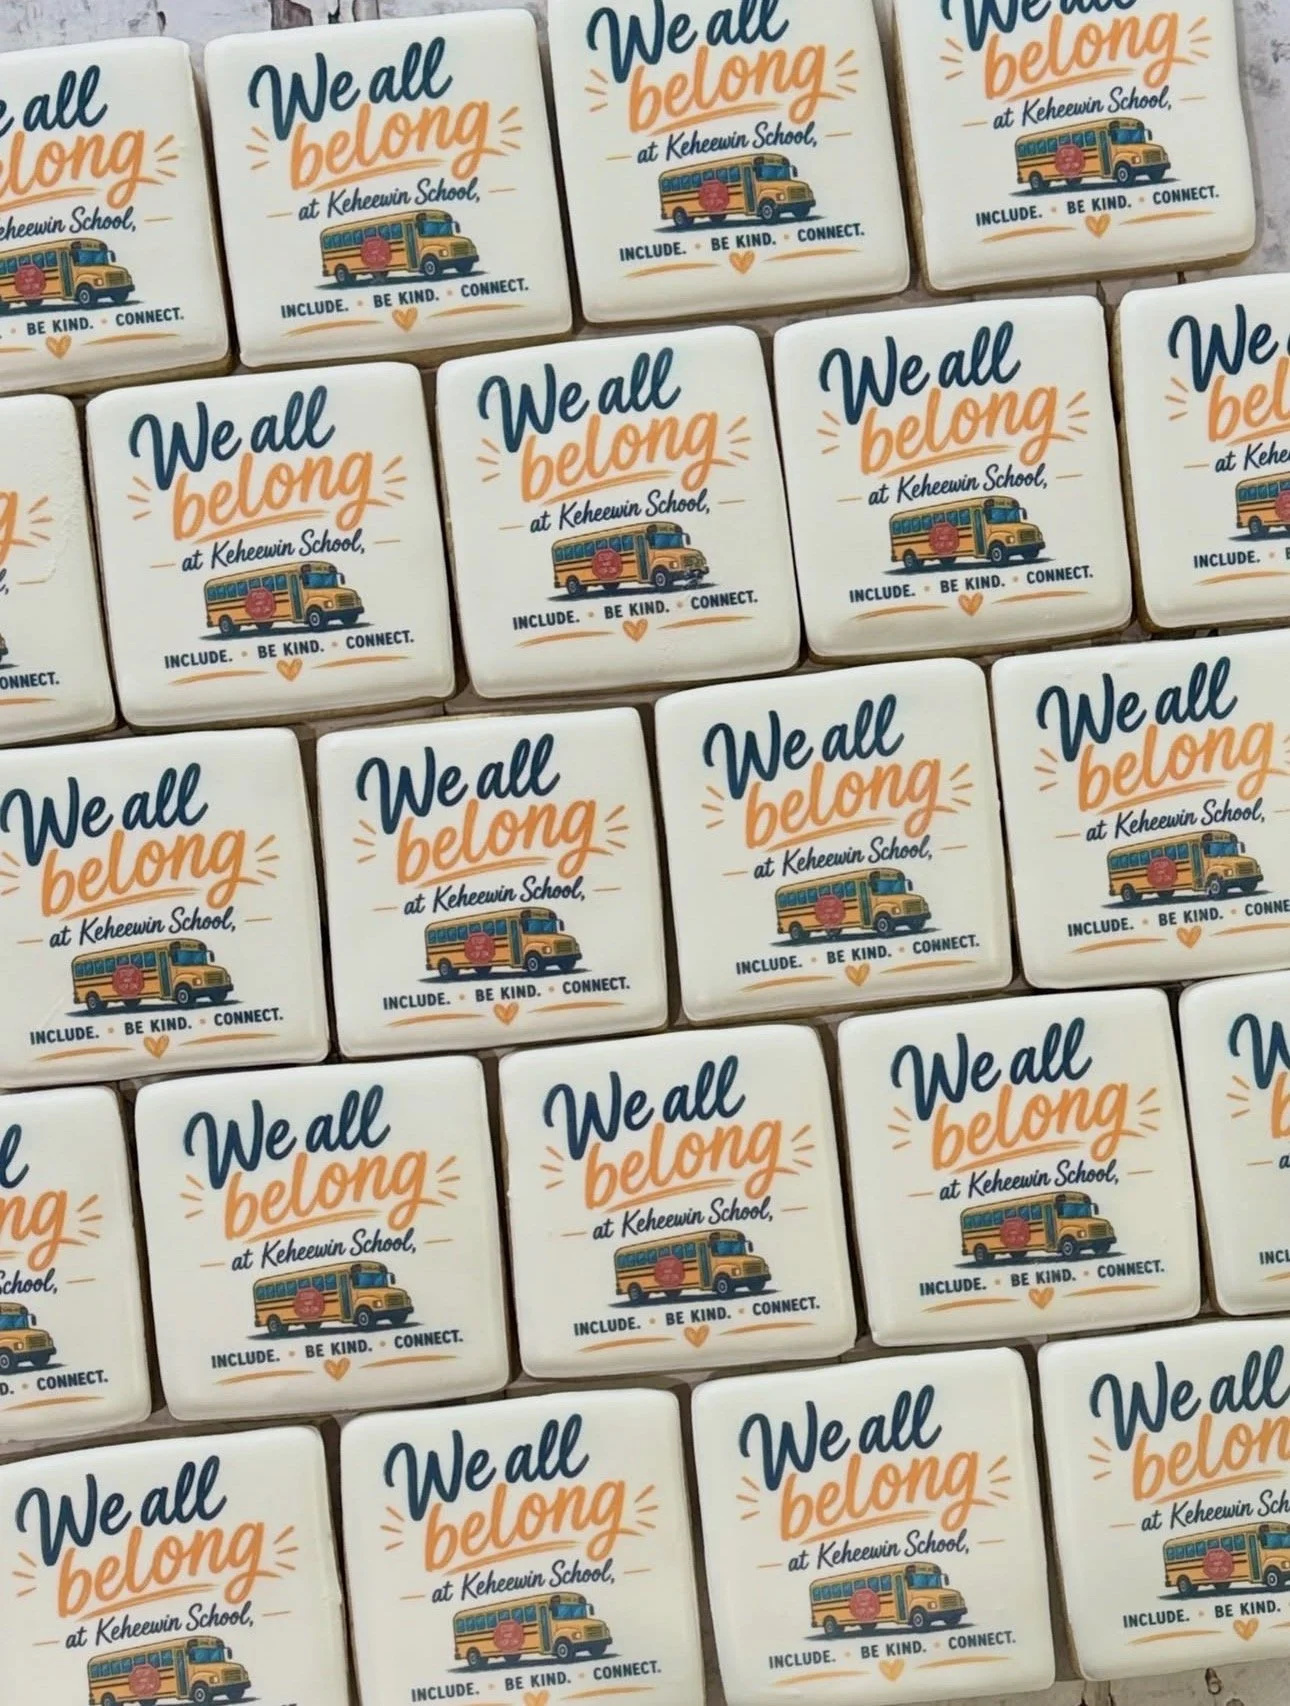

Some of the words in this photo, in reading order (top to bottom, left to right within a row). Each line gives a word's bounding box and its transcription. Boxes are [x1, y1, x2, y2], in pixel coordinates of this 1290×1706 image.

[586, 0, 698, 84] We
[706, 0, 790, 46] all
[984, 10, 1191, 99] belong
[22, 65, 108, 132] all
[246, 51, 360, 142] We
[368, 36, 453, 103] all
[628, 44, 837, 133] belong
[993, 107, 1015, 130] at
[1022, 96, 1104, 127] Keheewin
[1107, 85, 1172, 114] School,
[289, 100, 500, 190] belong
[637, 141, 659, 164] at
[666, 131, 750, 162] Keheewin
[752, 120, 817, 149] School,
[69, 205, 136, 234] School,
[976, 204, 1043, 225] INCLUDE.
[1067, 199, 1086, 214] BE
[1091, 194, 1132, 211] KIND.
[1152, 185, 1220, 205] CONNECT.
[619, 241, 687, 261] INCLUDE.
[710, 236, 730, 251] BE
[735, 232, 777, 249] KIND.
[797, 223, 865, 243] CONNECT.
[280, 297, 349, 318] INCLUDE.
[372, 292, 392, 308] BE
[398, 288, 439, 305] KIND.
[460, 278, 529, 298] CONNECT.
[26, 320, 46, 336] BE
[52, 316, 94, 333] KIND.
[115, 307, 184, 327] CONNECT.
[1168, 304, 1280, 393] We
[819, 335, 931, 426] We
[938, 321, 1022, 389] all
[128, 401, 243, 492] We
[250, 386, 336, 454] all
[860, 386, 1068, 475] belong
[868, 484, 890, 506] at
[896, 473, 980, 504] Keheewin
[982, 462, 1047, 492] School,
[1214, 451, 1236, 473] at
[172, 451, 385, 541] belong
[530, 510, 552, 533] at
[558, 499, 642, 531] Keheewin
[645, 487, 710, 518] School,
[181, 549, 204, 572] at
[211, 538, 296, 569] Keheewin
[299, 527, 365, 557] School,
[1193, 550, 1261, 569] INCLUDE.
[849, 583, 916, 604] INCLUDE.
[940, 578, 959, 594] BE
[964, 574, 1006, 591] KIND.
[1026, 565, 1093, 585] CONNECT.
[512, 610, 580, 631] INCLUDE.
[604, 604, 624, 620] BE
[628, 600, 670, 617] KIND.
[690, 590, 758, 610] CONNECT.
[164, 649, 233, 669] INCLUDE.
[257, 643, 277, 659] BE
[282, 639, 325, 657] KIND.
[345, 630, 415, 650] CONNECT.
[1036, 673, 1148, 763] We
[1155, 658, 1239, 725] all
[355, 747, 469, 836] We
[476, 734, 561, 800] all
[1077, 721, 1285, 811] belong
[0, 778, 114, 868] We
[122, 764, 209, 831] all
[1086, 819, 1108, 842] at
[1114, 808, 1198, 839] Keheewin
[1200, 796, 1265, 826] School,
[396, 798, 606, 884] belong
[753, 857, 775, 880] at
[782, 846, 865, 877] Keheewin
[868, 834, 932, 864] School,
[41, 829, 256, 917] belong
[403, 893, 425, 915] at
[432, 883, 517, 913] Keheewin
[519, 874, 585, 903] School,
[49, 925, 72, 948] at
[79, 915, 166, 946] Keheewin
[168, 905, 235, 934] School,
[1067, 917, 1135, 938] INCLUDE.
[1158, 911, 1178, 927] BE
[1183, 907, 1224, 924] KIND.
[735, 955, 803, 976] INCLUDE.
[826, 949, 846, 965] BE
[851, 945, 892, 962] KIND.
[912, 935, 980, 955] CONNECT.
[30, 1025, 100, 1045] INCLUDE.
[124, 1020, 144, 1036] BE
[150, 1017, 192, 1033] KIND.
[213, 1008, 283, 1028] CONNECT.
[542, 1071, 655, 1161] We
[662, 1056, 747, 1123] all
[181, 1101, 297, 1192] We
[304, 1086, 391, 1154] all
[584, 1120, 793, 1210] belong
[939, 1179, 961, 1201] at
[968, 1168, 1051, 1199] Keheewin
[1054, 1158, 1119, 1187] School,
[223, 1151, 437, 1241] belong
[592, 1218, 614, 1240] at
[621, 1207, 705, 1238] Keheewin
[708, 1195, 773, 1225] School,
[920, 1277, 987, 1297] INCLUDE.
[1011, 1272, 1030, 1287] BE
[1035, 1268, 1077, 1285] KIND.
[1097, 1260, 1165, 1279] CONNECT.
[574, 1316, 642, 1337] INCLUDE.
[665, 1311, 685, 1326] BE
[690, 1306, 732, 1324] KIND.
[752, 1297, 820, 1317] CONNECT.
[211, 1348, 280, 1369] INCLUDE.
[305, 1343, 325, 1359] BE
[330, 1339, 373, 1356] KIND.
[393, 1330, 463, 1350] CONNECT.
[36, 1369, 108, 1391] CONNECT.
[1089, 1361, 1202, 1452] We
[1210, 1346, 1290, 1414] all
[738, 1401, 851, 1492] We
[858, 1386, 943, 1454] all
[14, 1474, 132, 1568] We
[140, 1456, 228, 1527] all
[779, 1451, 990, 1541] belong
[1141, 1509, 1163, 1532] at
[1170, 1498, 1254, 1529] Keheewin
[57, 1522, 275, 1618] belong
[788, 1550, 810, 1573] at
[817, 1539, 901, 1570] Keheewin
[904, 1528, 969, 1557] School,
[431, 1581, 454, 1604] at
[461, 1570, 546, 1601] Keheewin
[549, 1557, 615, 1588] School,
[65, 1626, 88, 1650] at
[95, 1614, 183, 1646] Keheewin
[185, 1600, 253, 1632] School,
[1123, 1609, 1191, 1629] INCLUDE.
[1215, 1603, 1234, 1619] BE
[1239, 1600, 1281, 1617] KIND.
[768, 1650, 837, 1670] INCLUDE.
[860, 1644, 880, 1660] BE
[885, 1640, 927, 1657] KIND.
[948, 1631, 1016, 1651] CONNECT.
[411, 1682, 480, 1703] INCLUDE.
[504, 1676, 524, 1692] BE
[530, 1671, 572, 1689] KIND.
[592, 1661, 661, 1682] CONNECT.
